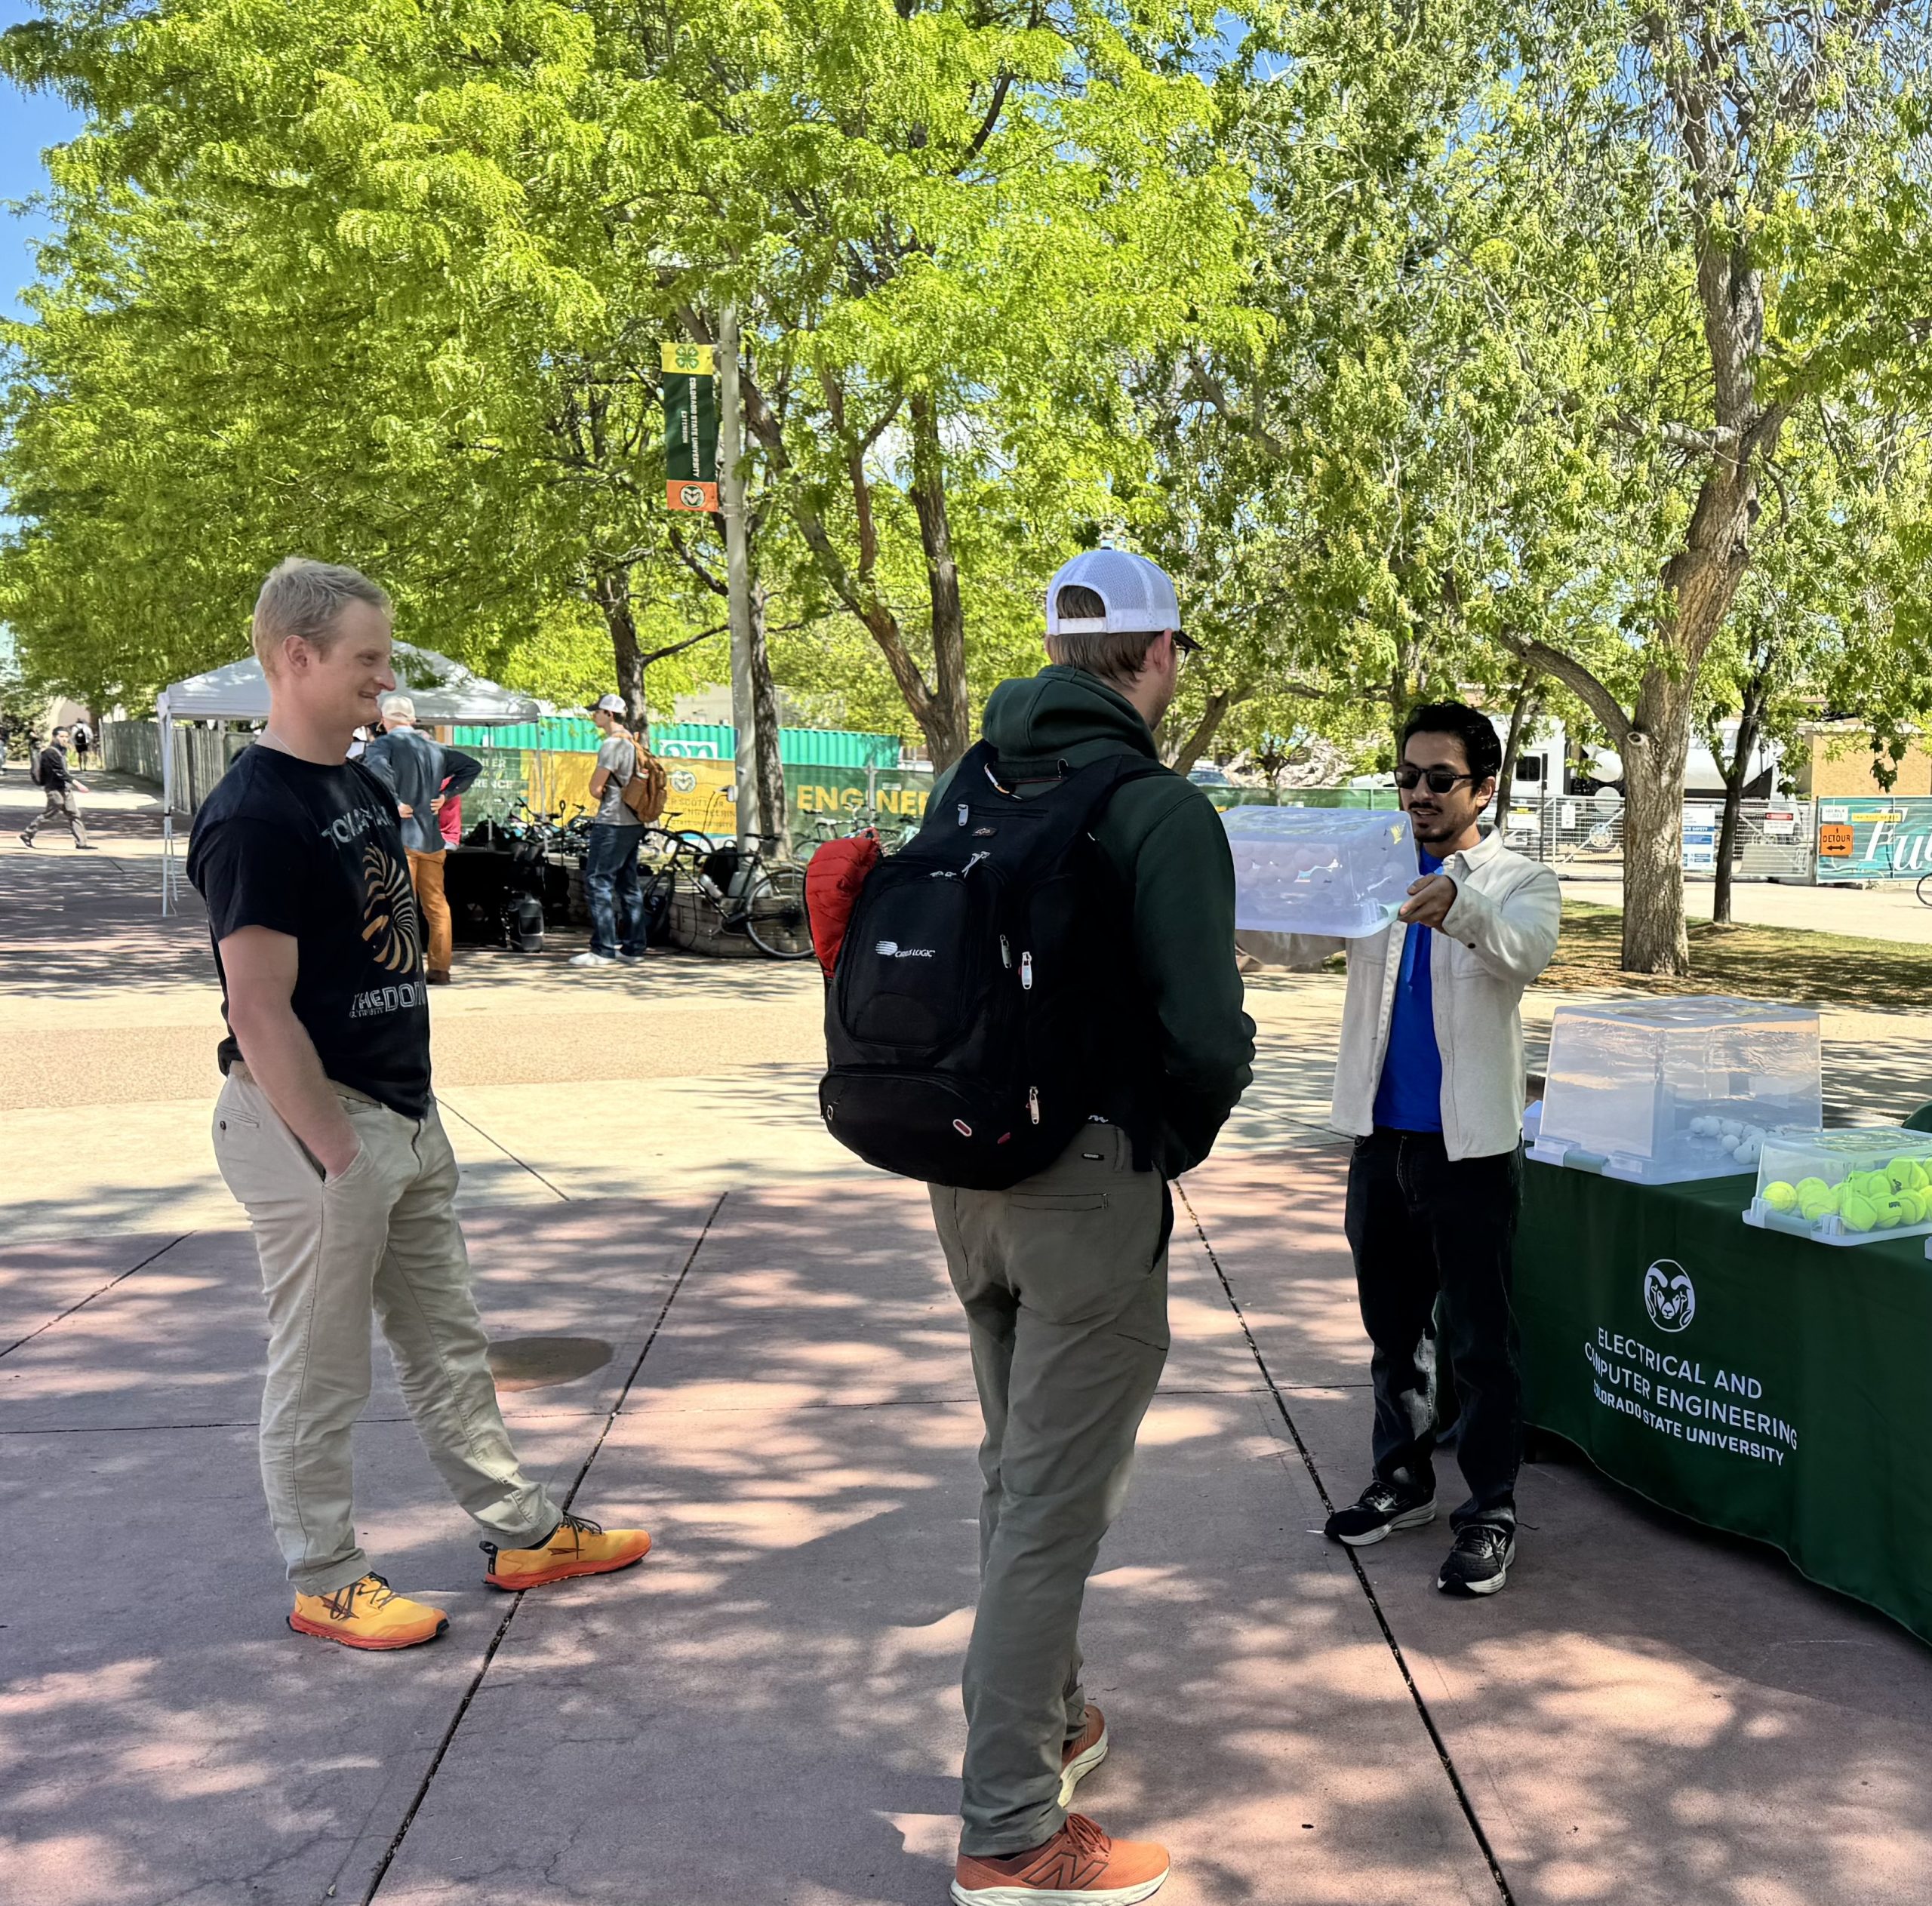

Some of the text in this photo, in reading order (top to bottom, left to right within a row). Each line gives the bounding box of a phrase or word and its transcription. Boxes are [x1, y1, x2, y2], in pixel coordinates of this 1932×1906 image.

[690, 414, 698, 436] STATE
[691, 437, 700, 478] UNIVERSITY
[1823, 835, 1850, 843] DETOUR
[912, 949, 936, 958] LOGIC
[1598, 1327, 1762, 1400] ELECTRICAL AND
[1585, 1342, 1798, 1451] CMPUTER ENGINEERING
[1642, 1408, 1682, 1438] STATE
[1686, 1425, 1785, 1467] UNIVERSITY
